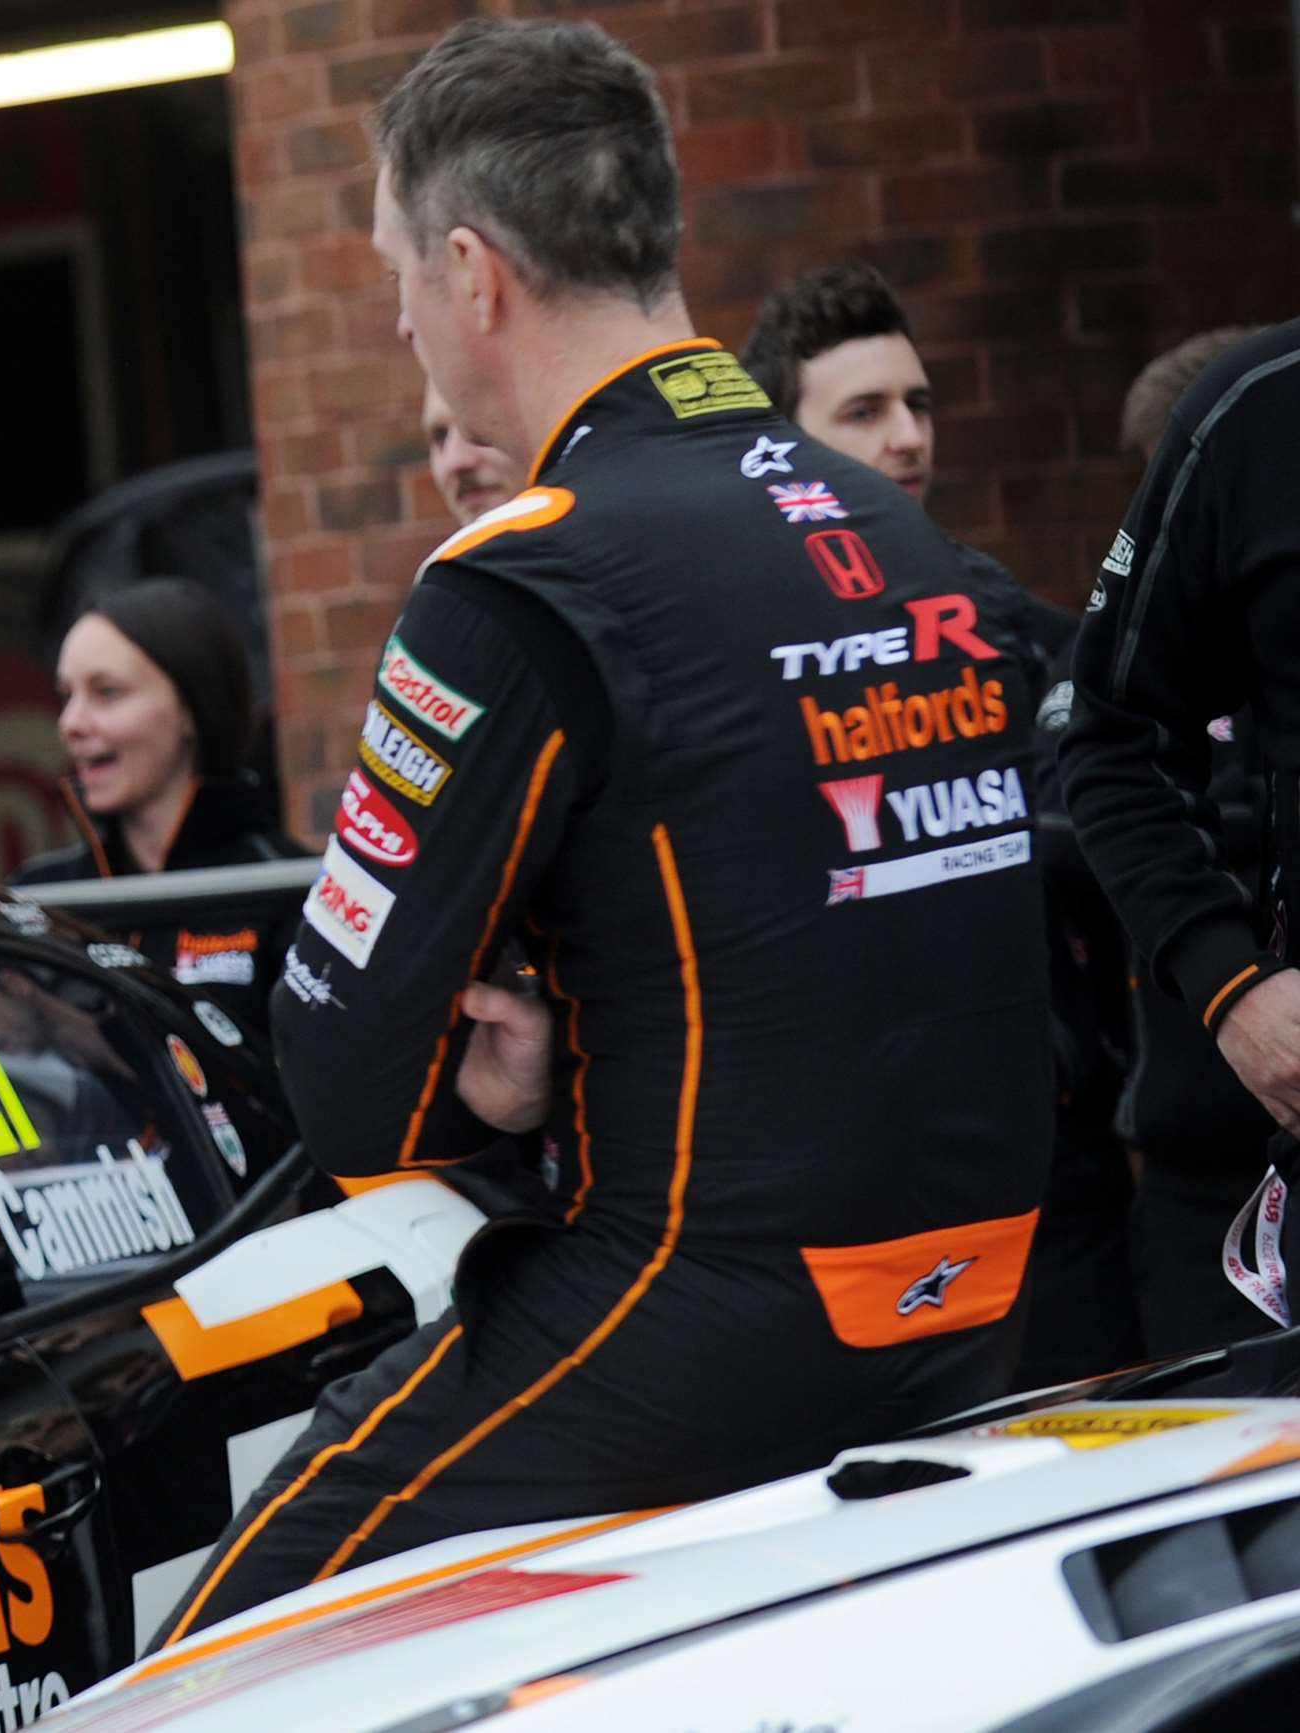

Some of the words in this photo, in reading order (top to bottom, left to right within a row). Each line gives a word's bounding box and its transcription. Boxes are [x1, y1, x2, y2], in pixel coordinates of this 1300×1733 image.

[770, 626, 910, 680] TYPE
[903, 593, 1001, 662] R
[387, 657, 468, 731] Castrol
[798, 666, 1008, 766] halfords
[885, 767, 1029, 842] YUASA
